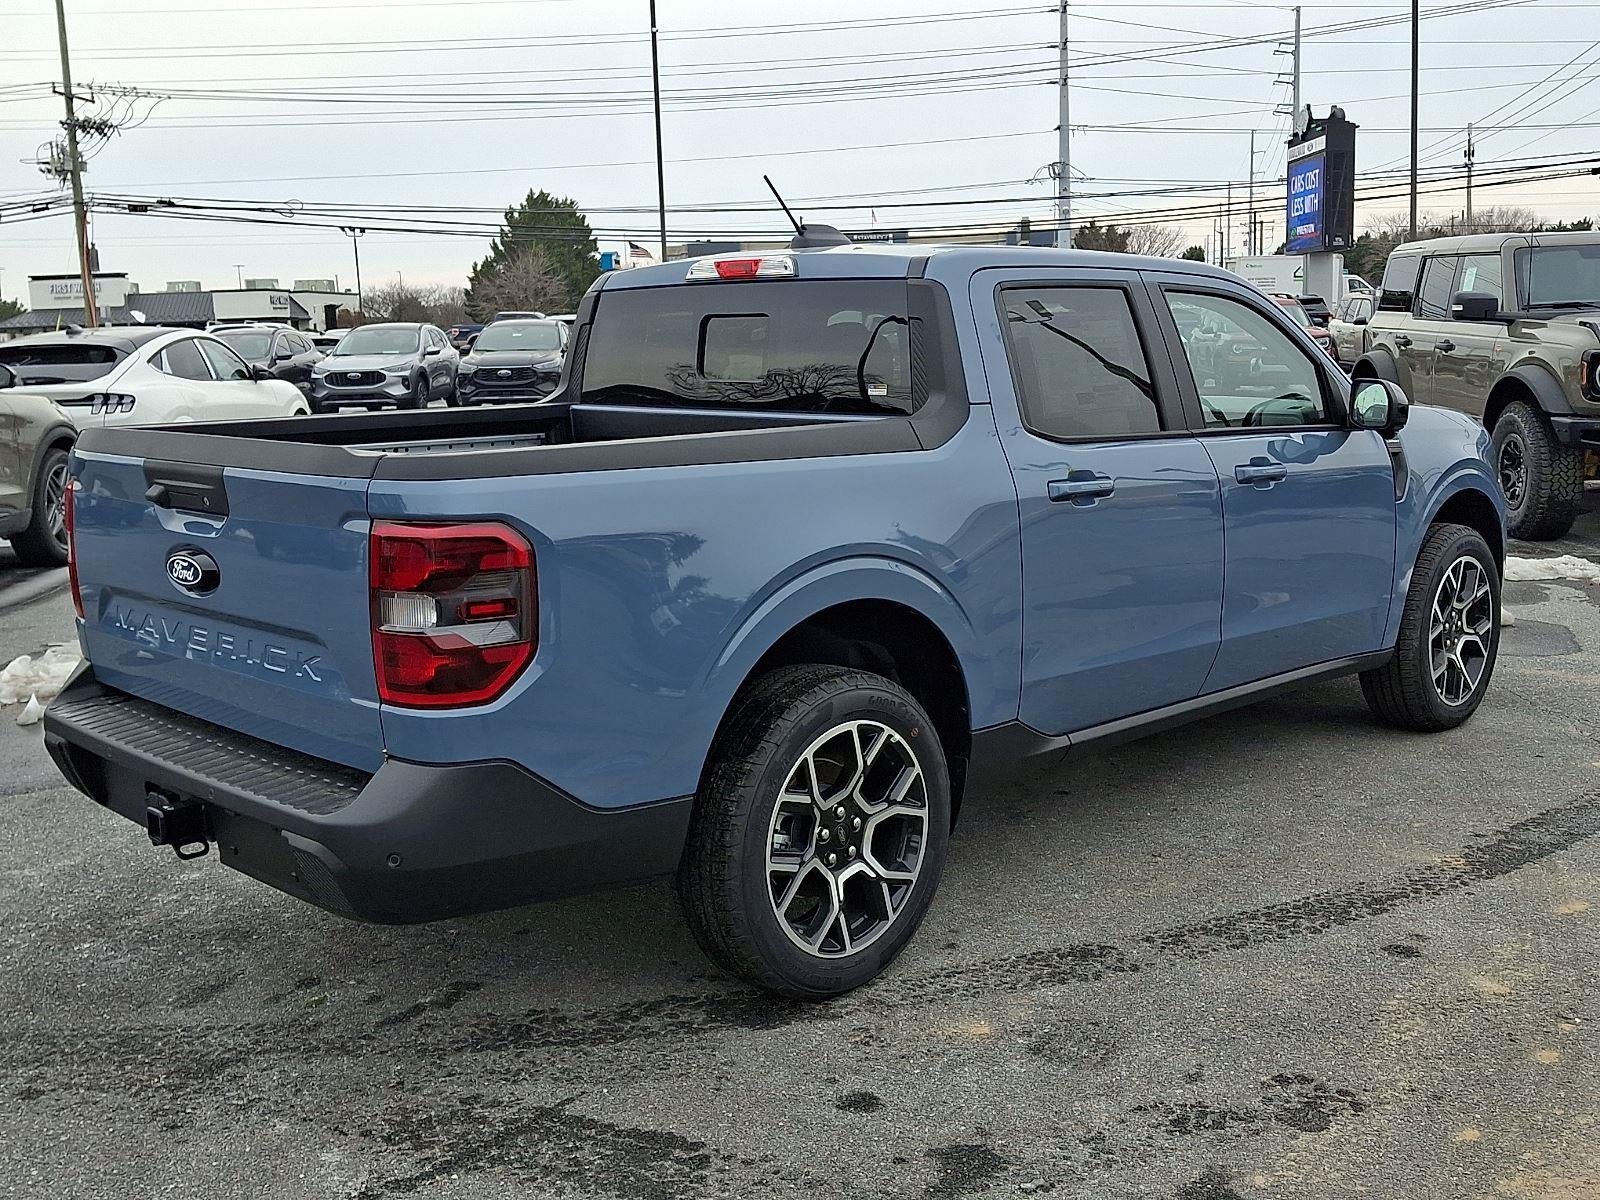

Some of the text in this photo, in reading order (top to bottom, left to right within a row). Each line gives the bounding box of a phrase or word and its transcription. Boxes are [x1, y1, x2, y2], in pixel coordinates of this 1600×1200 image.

[1291, 169, 1320, 194] CARS COST
[1291, 197, 1304, 217] LESS
[173, 559, 195, 581] Ford
[115, 605, 322, 682] MAVERICK
